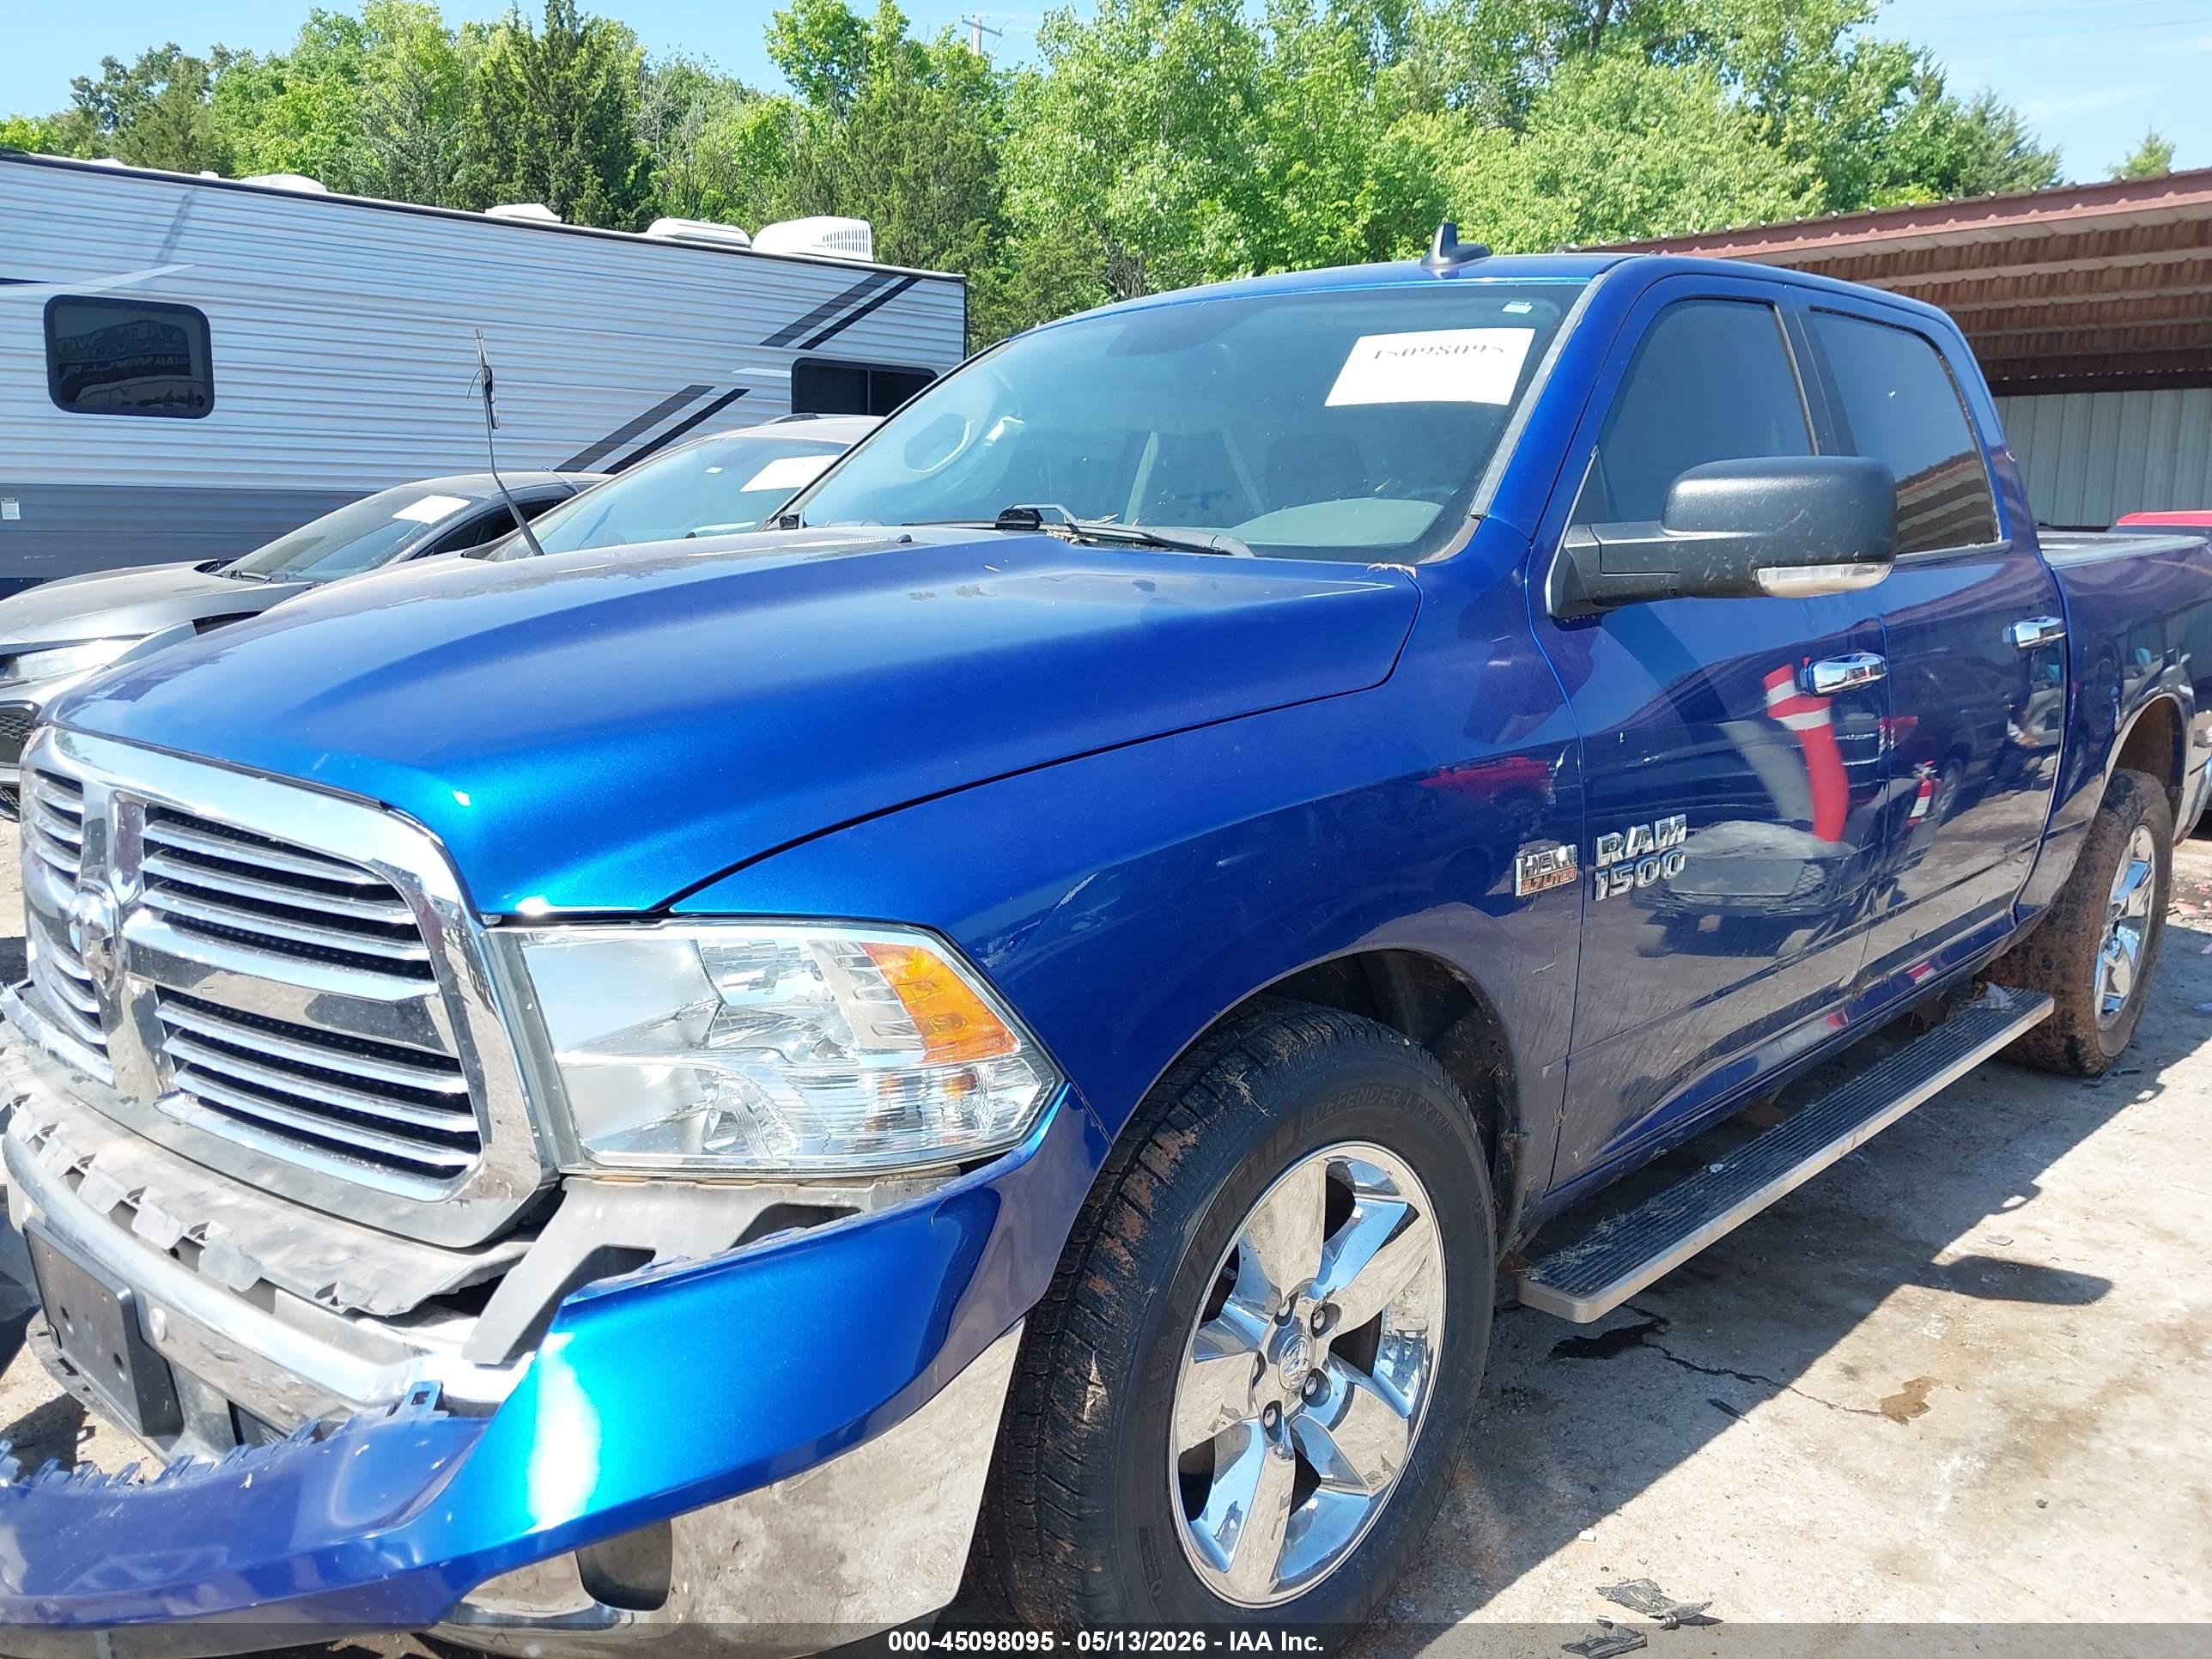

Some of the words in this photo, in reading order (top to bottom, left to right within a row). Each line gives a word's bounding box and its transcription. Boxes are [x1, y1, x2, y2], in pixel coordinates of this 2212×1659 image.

[1596, 813, 1686, 867] RAM
[1518, 844, 1577, 878] HEMI
[1595, 848, 1686, 901] 1500
[1522, 878, 1540, 893] 5.7
[1544, 867, 1577, 887] LITER
[1312, 1085, 1402, 1122] DEFENDER
[1405, 1093, 1434, 1121] LTX
